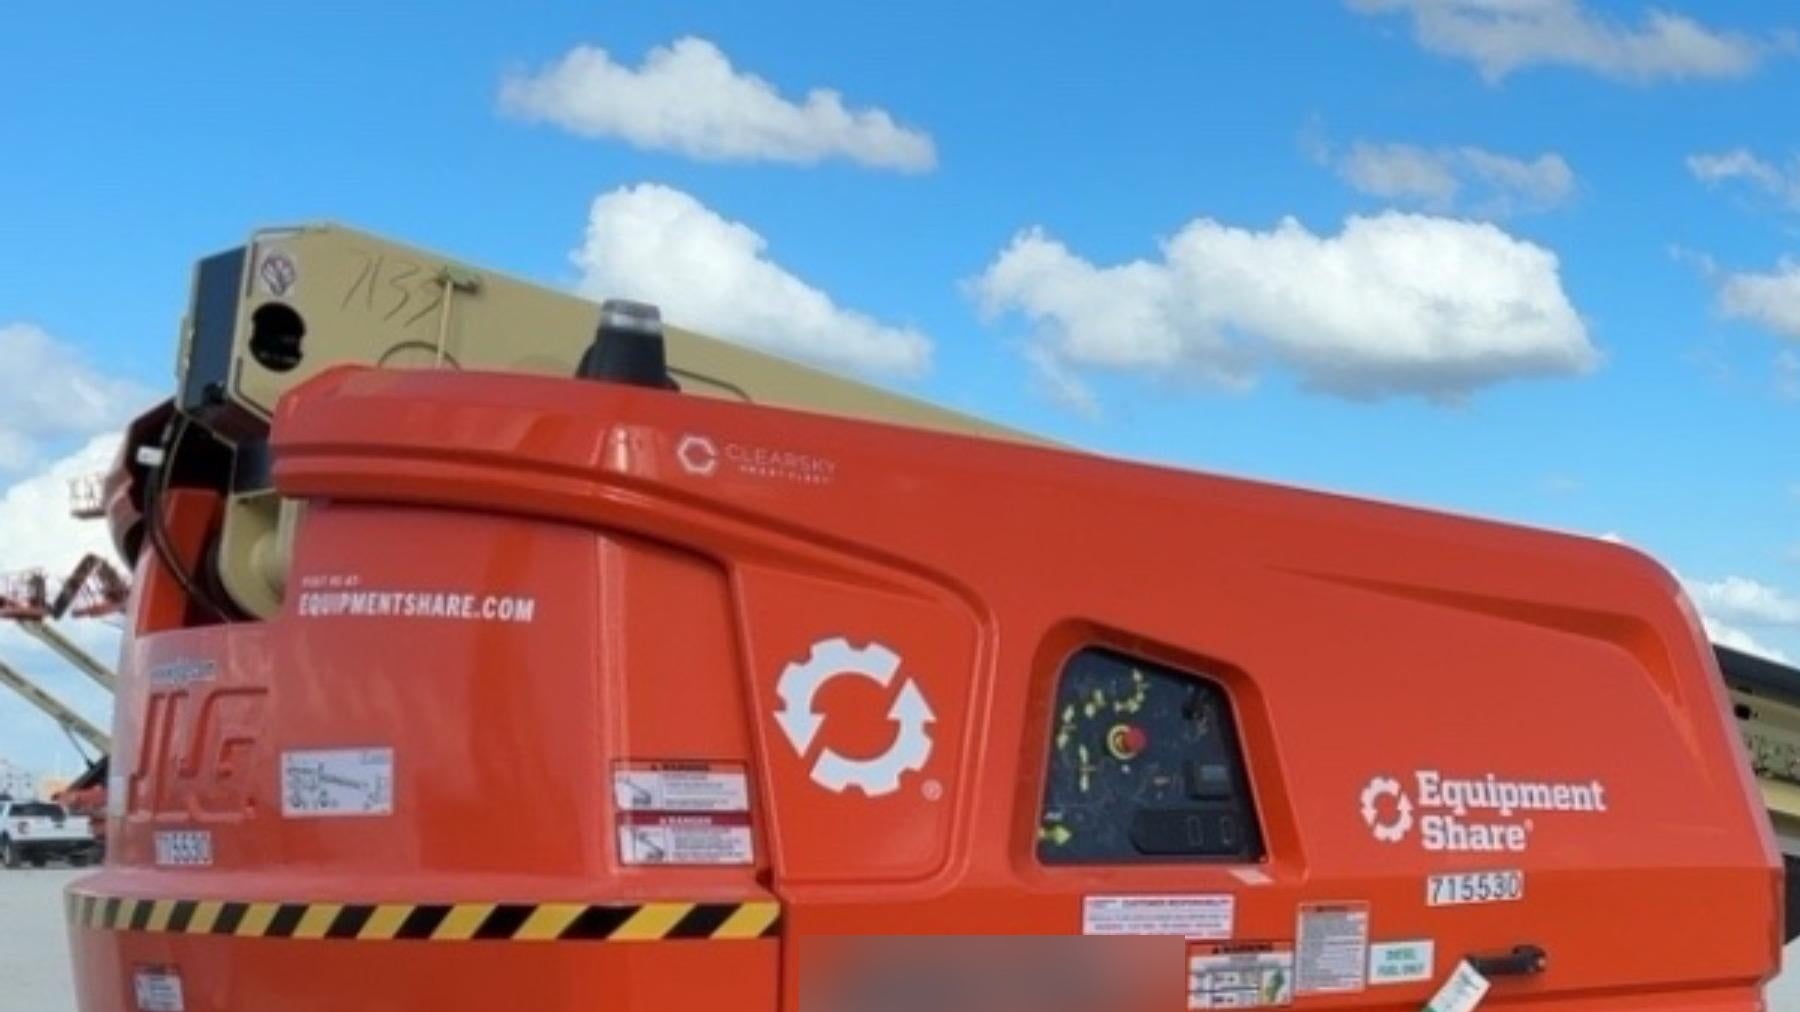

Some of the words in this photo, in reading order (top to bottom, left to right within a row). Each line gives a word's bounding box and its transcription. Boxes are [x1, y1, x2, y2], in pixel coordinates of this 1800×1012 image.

[725, 443, 838, 474] CLEARSKY
[298, 590, 535, 623] EQUIPMENTSHARE.COM
[1415, 769, 1607, 817] Equipment
[1431, 871, 1520, 905] 715530
